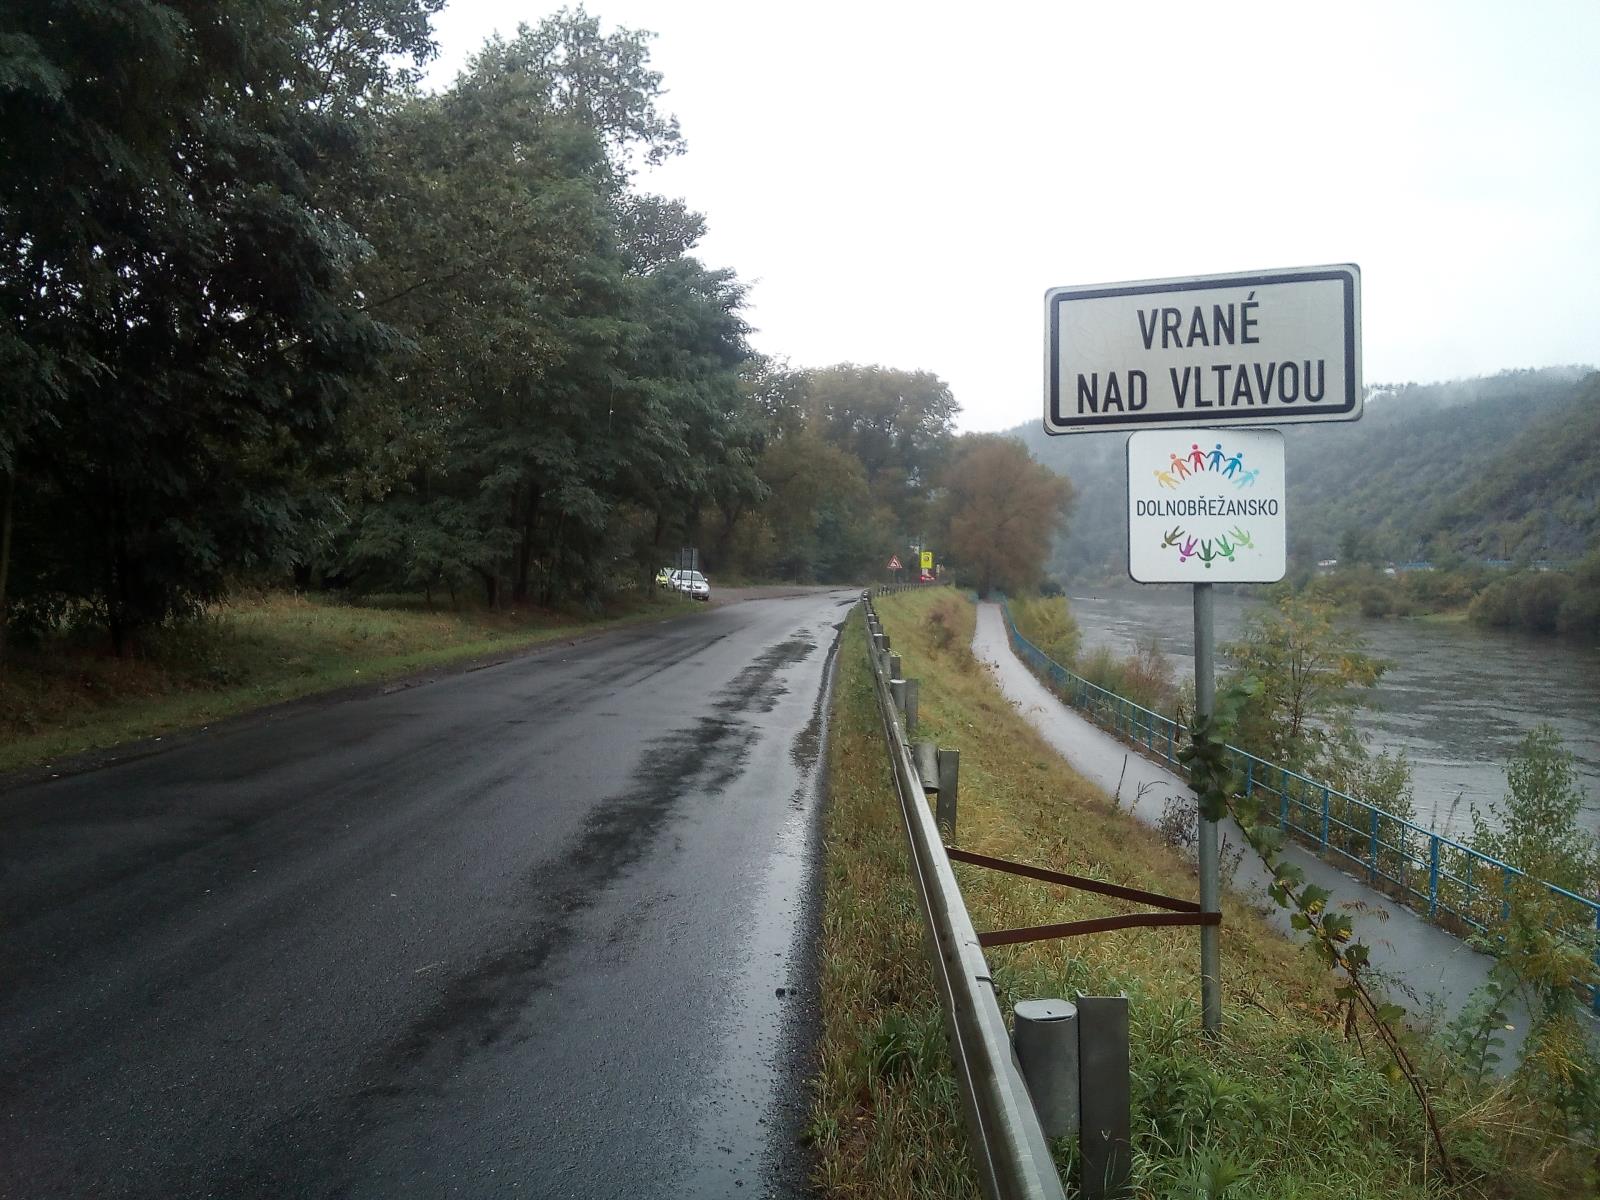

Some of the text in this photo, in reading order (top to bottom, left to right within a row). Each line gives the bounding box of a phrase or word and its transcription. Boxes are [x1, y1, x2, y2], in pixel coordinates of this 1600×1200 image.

[1137, 291, 1260, 350] VRANÉ
[1077, 359, 1325, 414] NAD VLTAVOU
[1136, 495, 1279, 517] DOLNOBŘEŽANSKO
